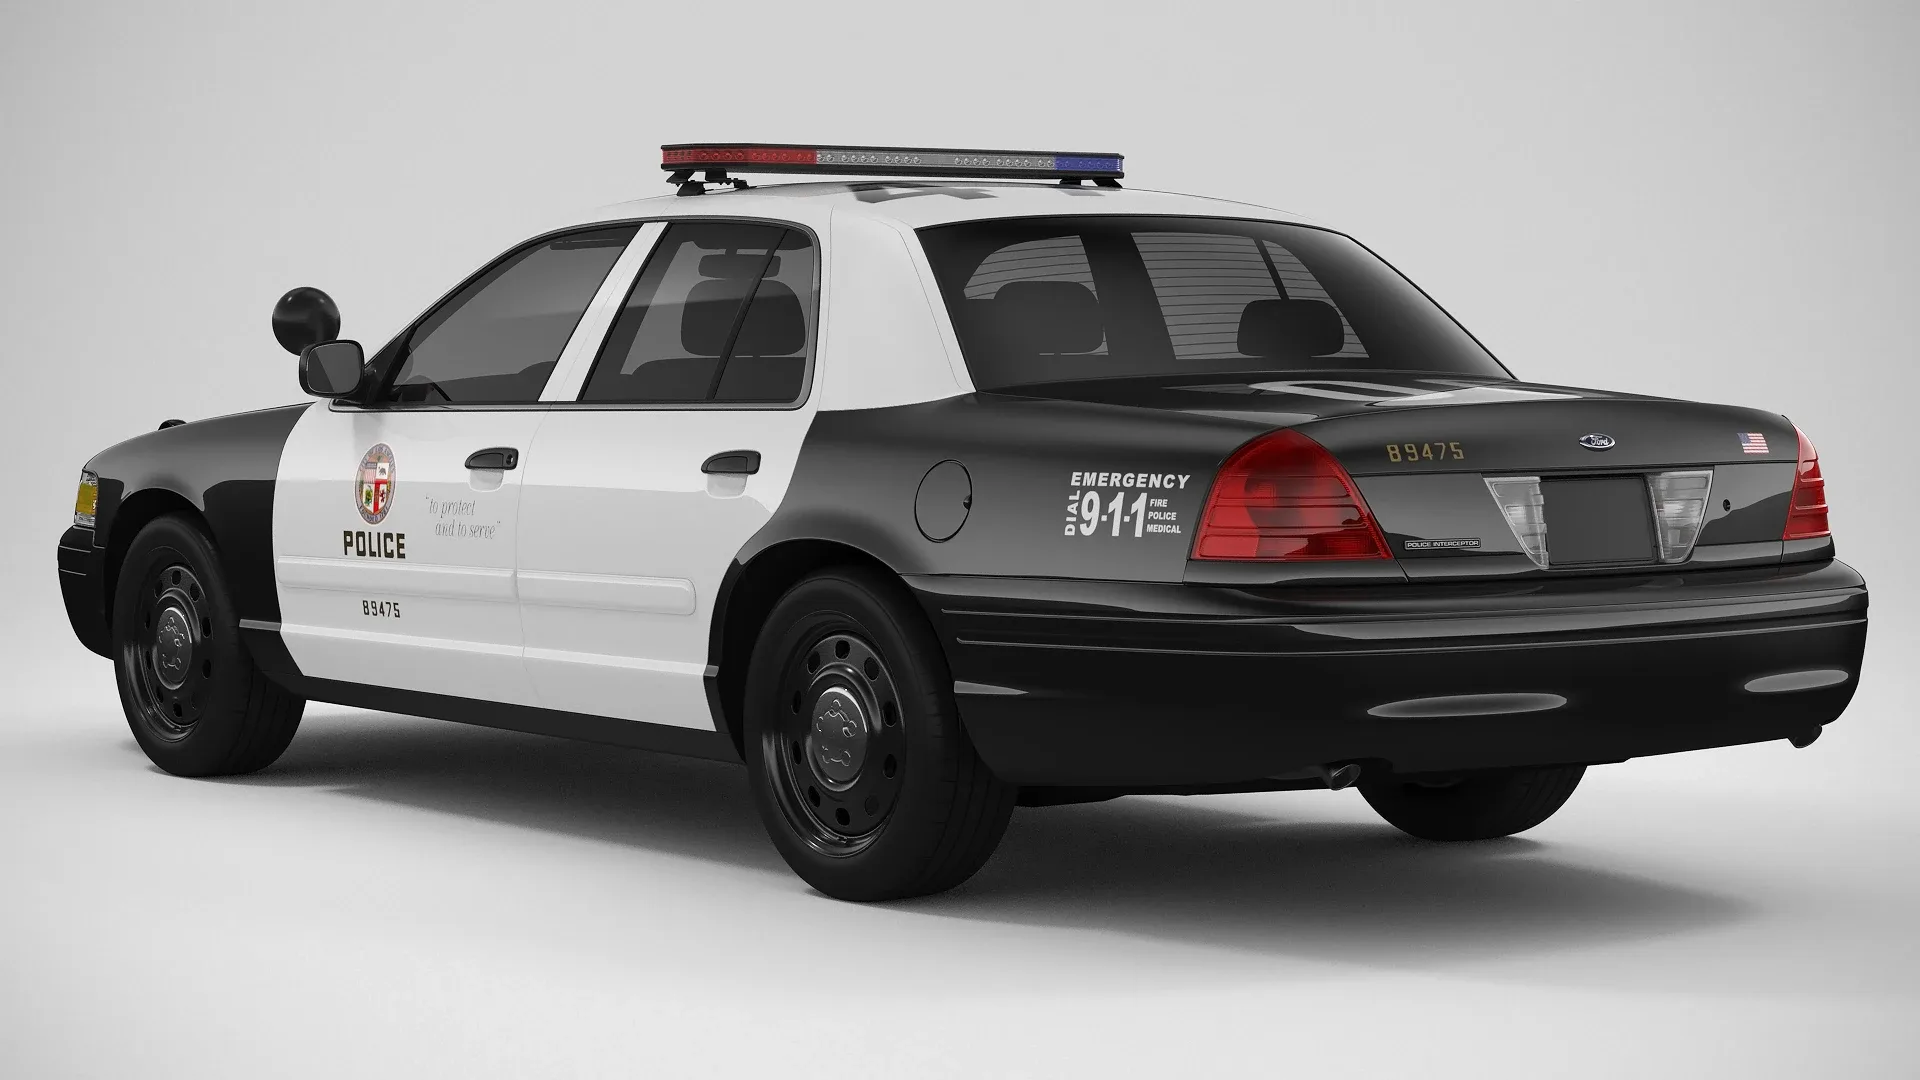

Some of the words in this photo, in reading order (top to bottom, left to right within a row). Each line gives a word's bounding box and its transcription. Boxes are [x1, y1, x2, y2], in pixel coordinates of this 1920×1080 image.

[1386, 441, 1465, 462] 89475
[1070, 471, 1191, 489] EMERGENCY
[440, 499, 476, 519] protect
[1149, 498, 1169, 508] FIRE
[1064, 489, 1081, 536] DIAL
[1079, 490, 1148, 538] 9-1-1
[1147, 511, 1177, 521] POLICE
[435, 519, 455, 537] and
[457, 521, 467, 537] to
[1146, 524, 1182, 534] MEDICAL
[343, 530, 406, 559] POLICE
[362, 600, 401, 618] 89475
